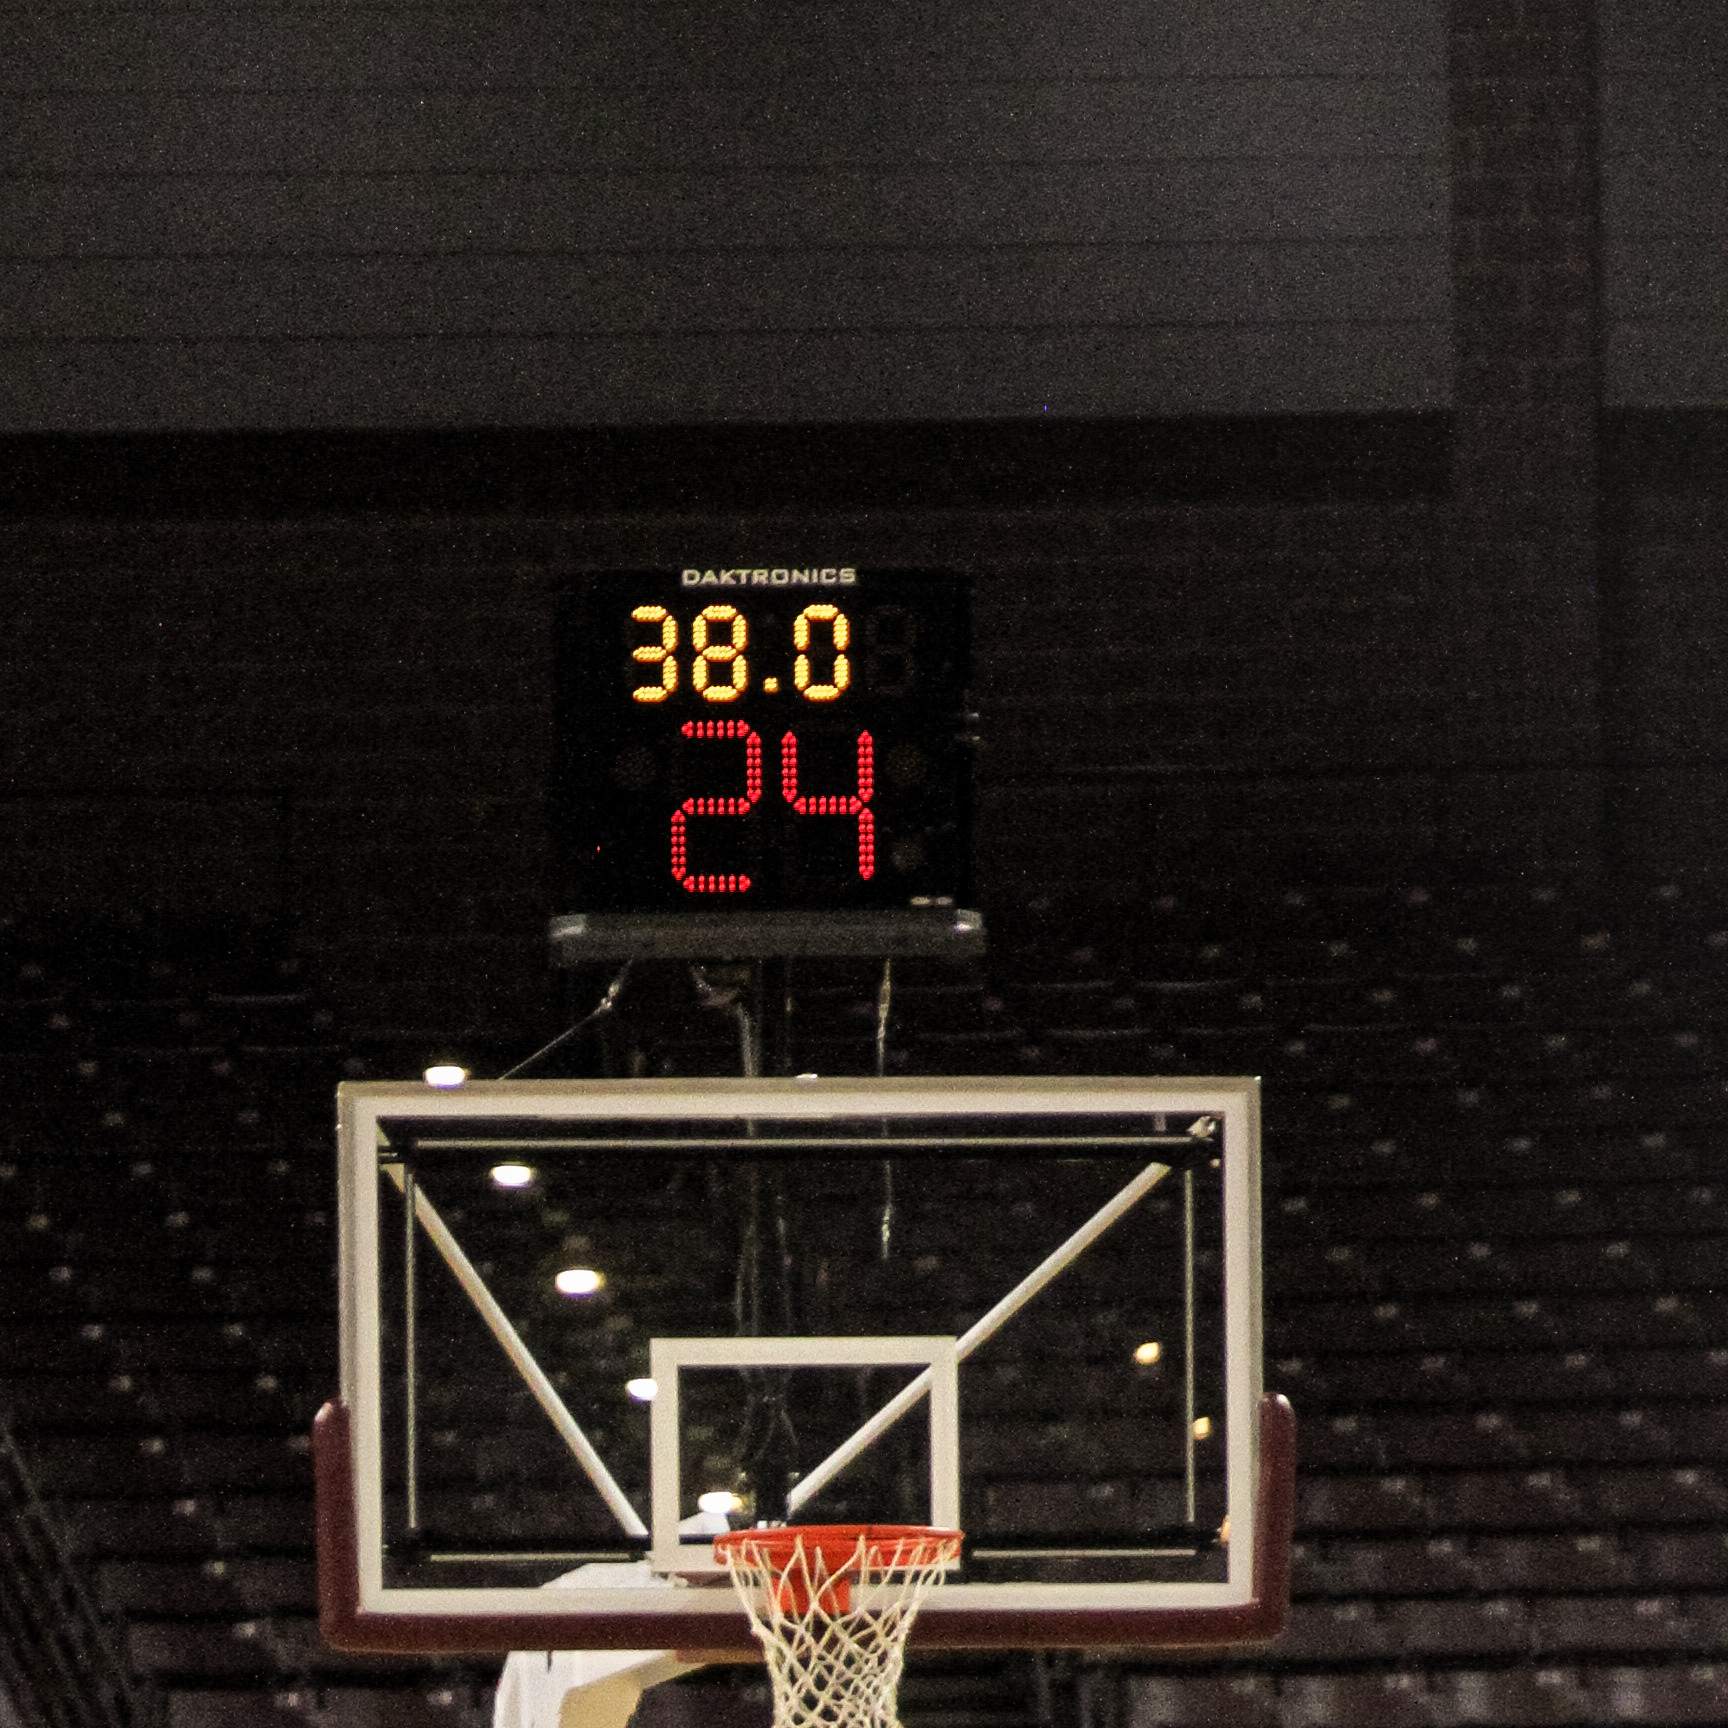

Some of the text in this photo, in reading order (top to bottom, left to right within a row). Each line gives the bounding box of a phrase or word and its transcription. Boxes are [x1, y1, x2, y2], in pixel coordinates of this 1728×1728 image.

[682, 567, 857, 586] DAKTRONICS
[631, 604, 850, 702] 38.0
[671, 720, 874, 893] 24
